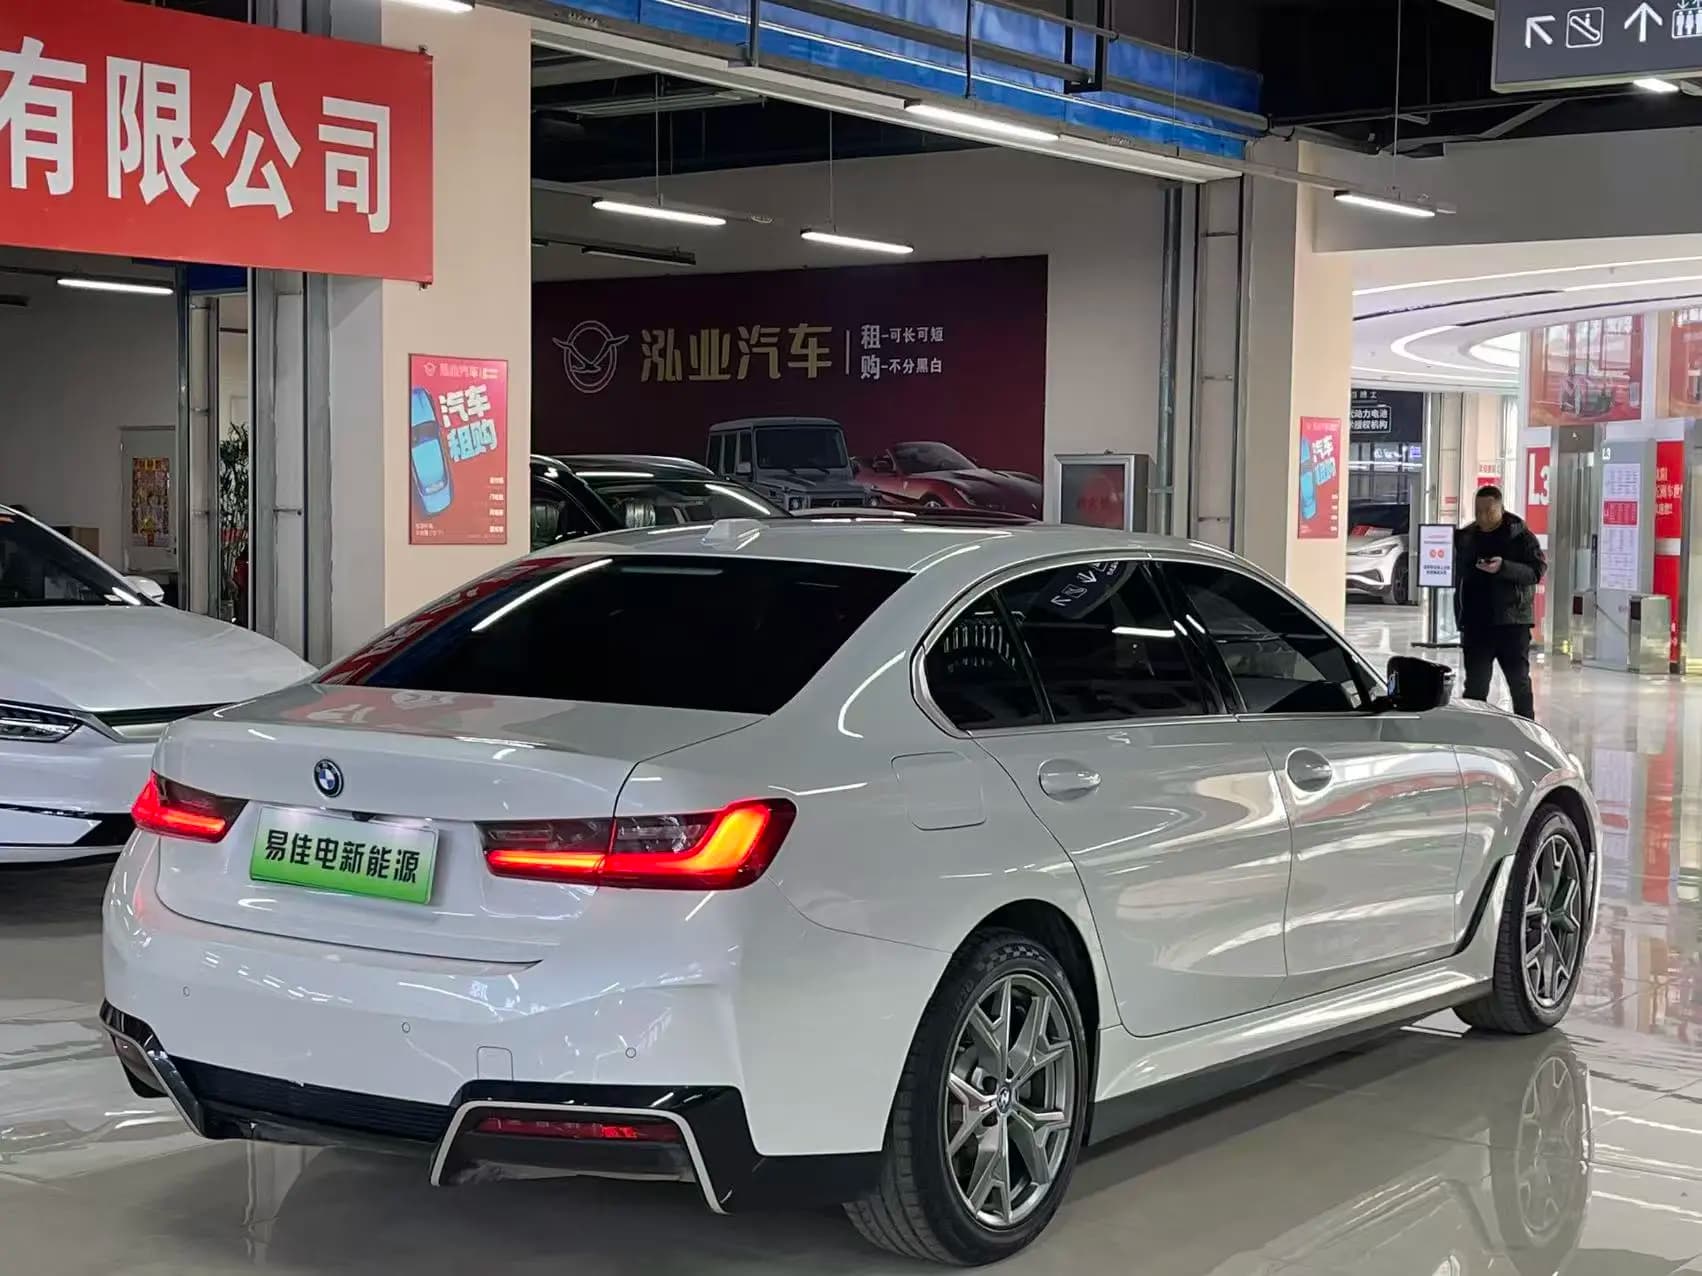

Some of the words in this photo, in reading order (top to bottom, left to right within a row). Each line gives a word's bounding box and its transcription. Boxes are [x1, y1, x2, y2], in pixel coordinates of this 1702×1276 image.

[0, 36, 391, 233] 有限公司
[641, 323, 833, 382] 泓业汽车
[439, 384, 492, 428] 汽车
[265, 829, 421, 884] 易佳电新能源
